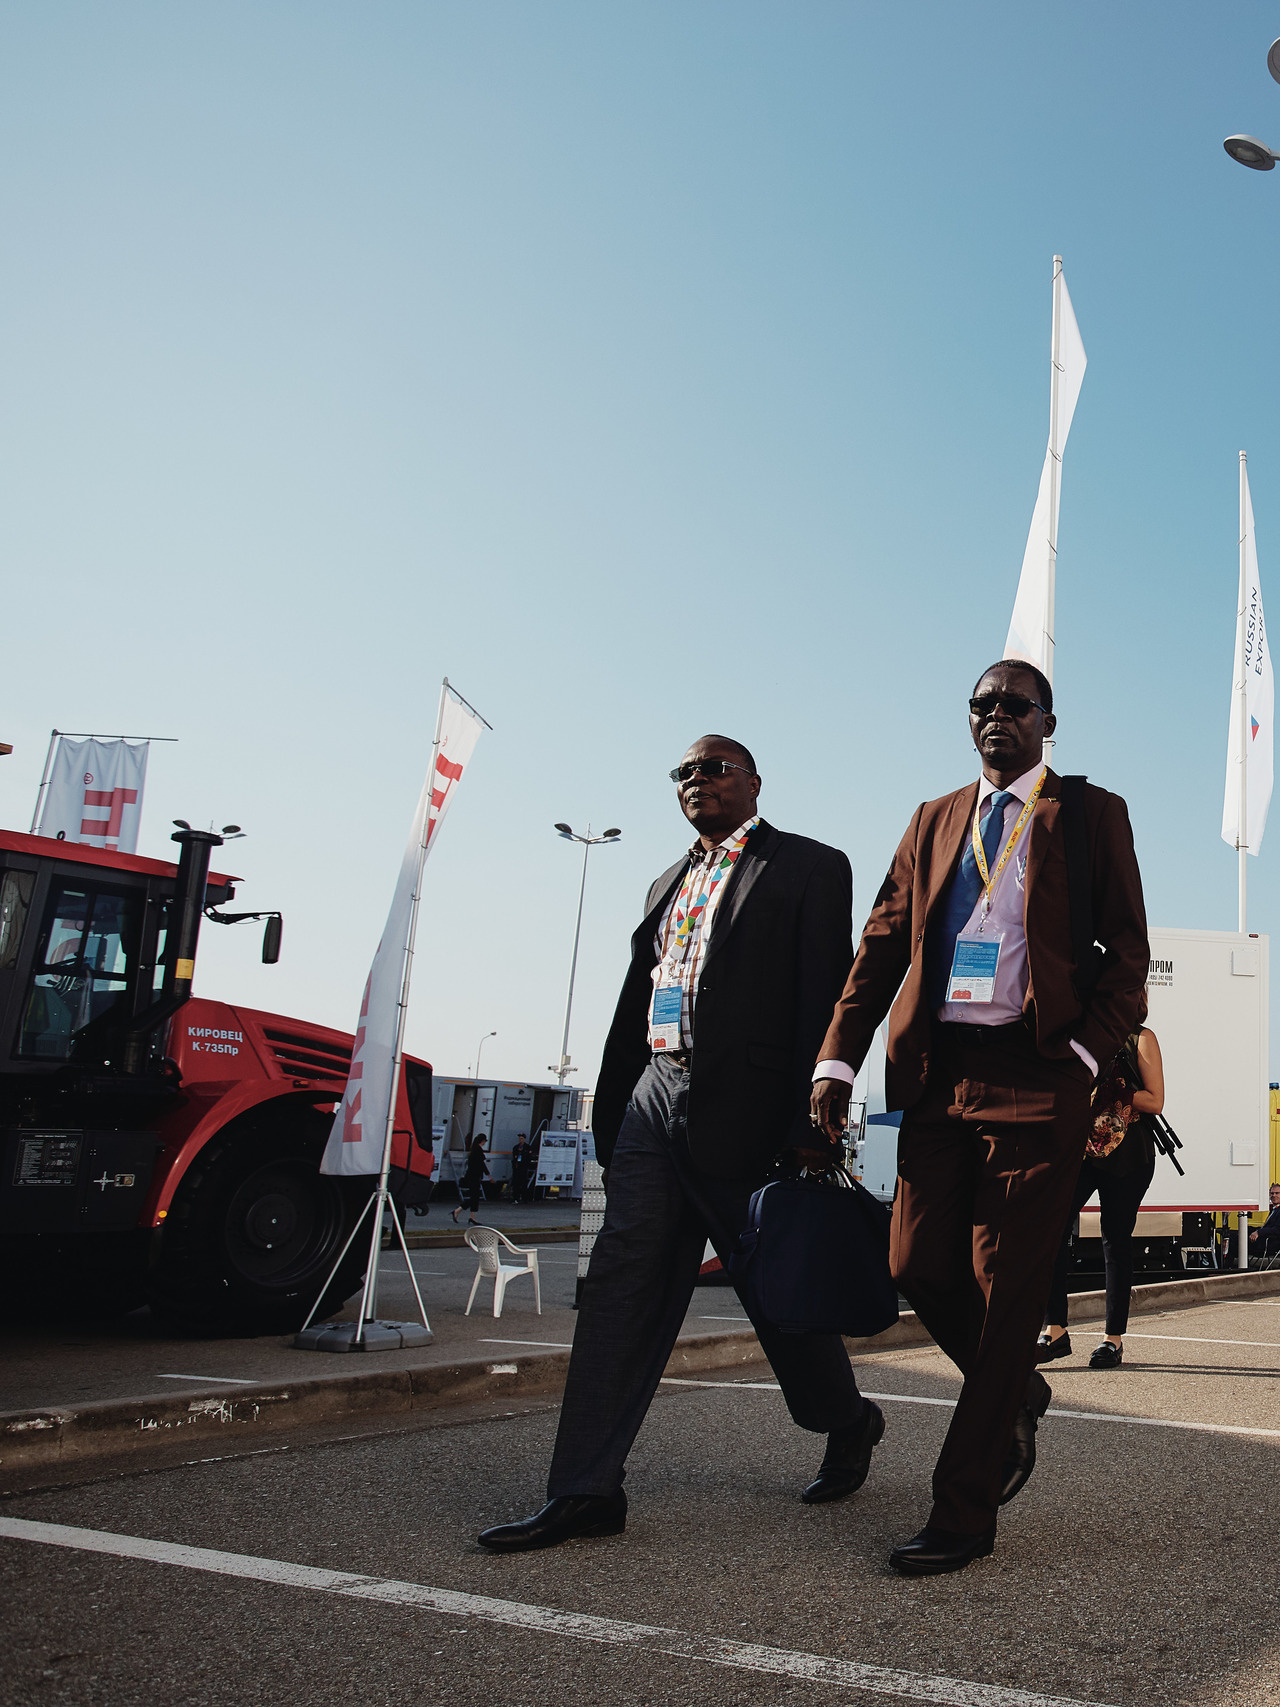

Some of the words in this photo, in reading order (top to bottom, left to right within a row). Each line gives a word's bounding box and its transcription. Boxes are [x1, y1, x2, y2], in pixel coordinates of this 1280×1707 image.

[1150, 960, 1173, 973] ПРОМ
[188, 1027, 243, 1042] КИРОВЕЦ
[192, 1041, 239, 1056] К-735Пр
